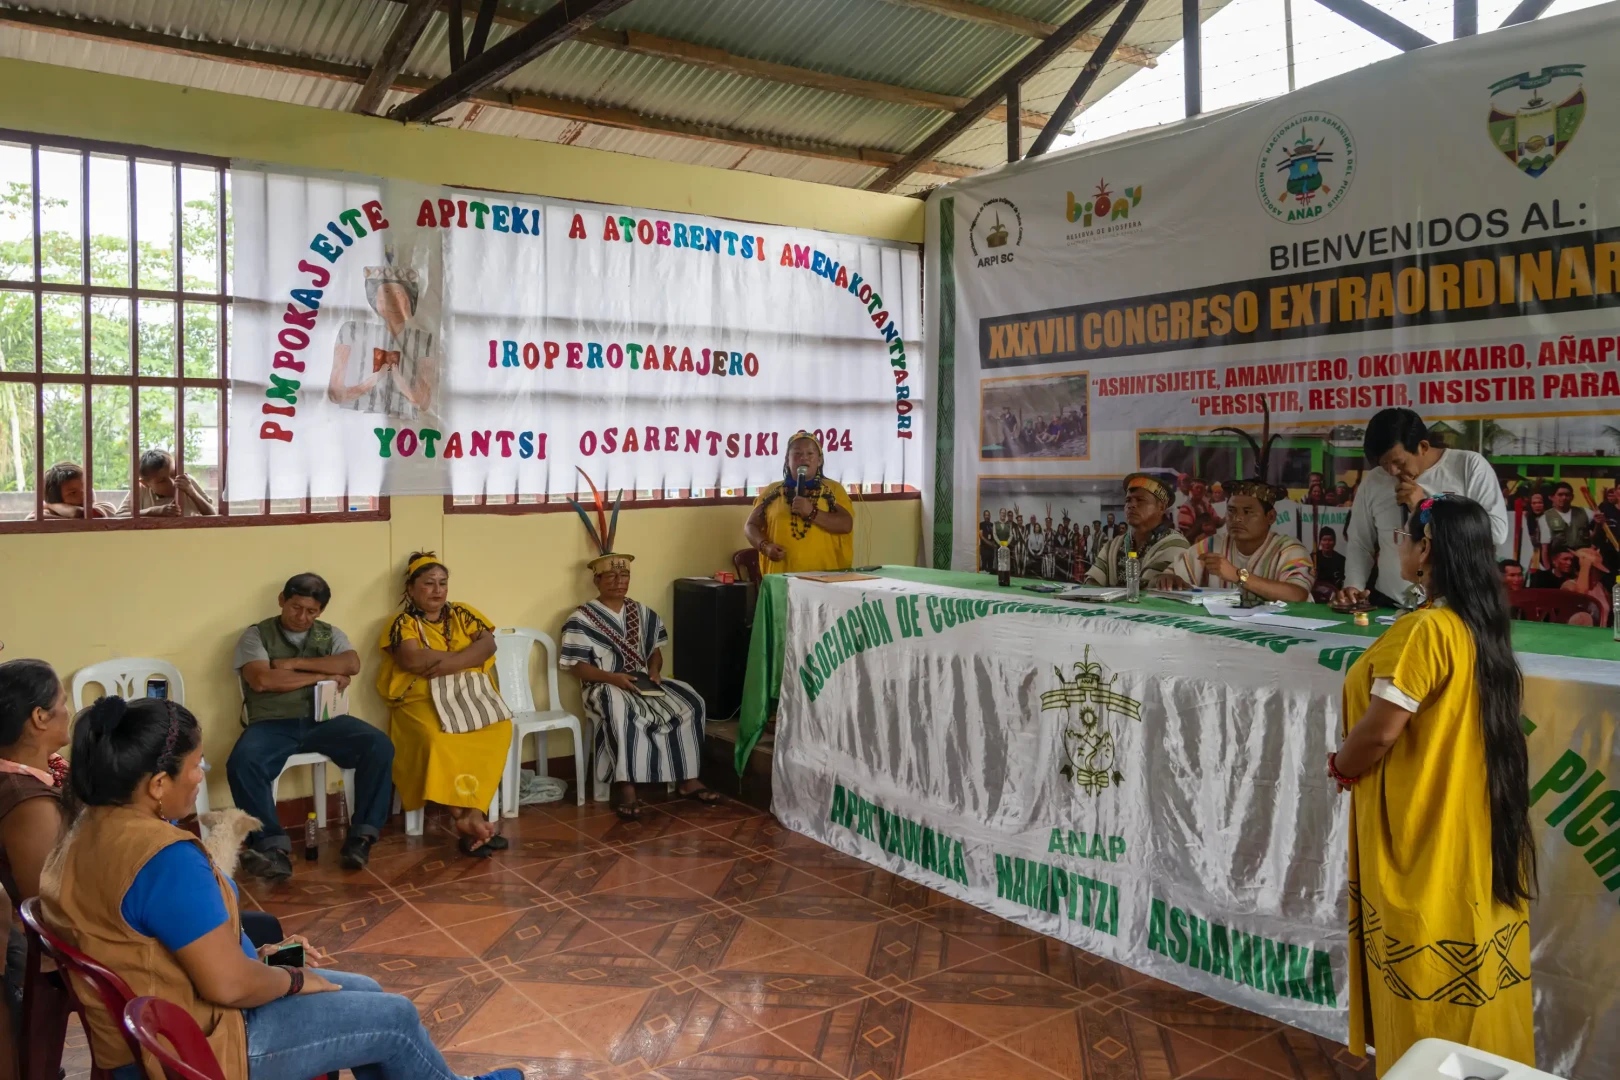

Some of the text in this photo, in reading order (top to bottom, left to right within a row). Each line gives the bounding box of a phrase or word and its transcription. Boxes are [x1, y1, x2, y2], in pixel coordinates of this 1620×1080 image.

[1270, 199, 1587, 271] BIENVENIDOS AL:
[1287, 205, 1322, 221] ANAP
[977, 252, 1014, 268] ARPI SC
[260, 200, 389, 442] PIMPOKAJEITE
[416, 199, 541, 236] APITEKI
[569, 213, 587, 239] A
[603, 215, 766, 261] ATOERENTSI
[988, 241, 1620, 360] XXXVII CONGRESO EXTRAORDINAR
[488, 340, 759, 377] IROPEROTAKAJERO
[1224, 357, 1354, 389] AMAWITERO,
[1358, 342, 1532, 378] OKOWAKAIRO,
[1308, 383, 1413, 411] RESISTIR,
[1419, 376, 1536, 405] INSISTIR
[1543, 369, 1620, 399] PARA
[374, 426, 853, 460] YOTANTSI OSARENTSIKI 024
[798, 592, 893, 702] ASOCIACIÓN
[896, 594, 923, 638] DE
[1047, 828, 1127, 863] ANAP
[830, 784, 1338, 1008] APATYAWAKA NAMPITZI ASHANINKA
